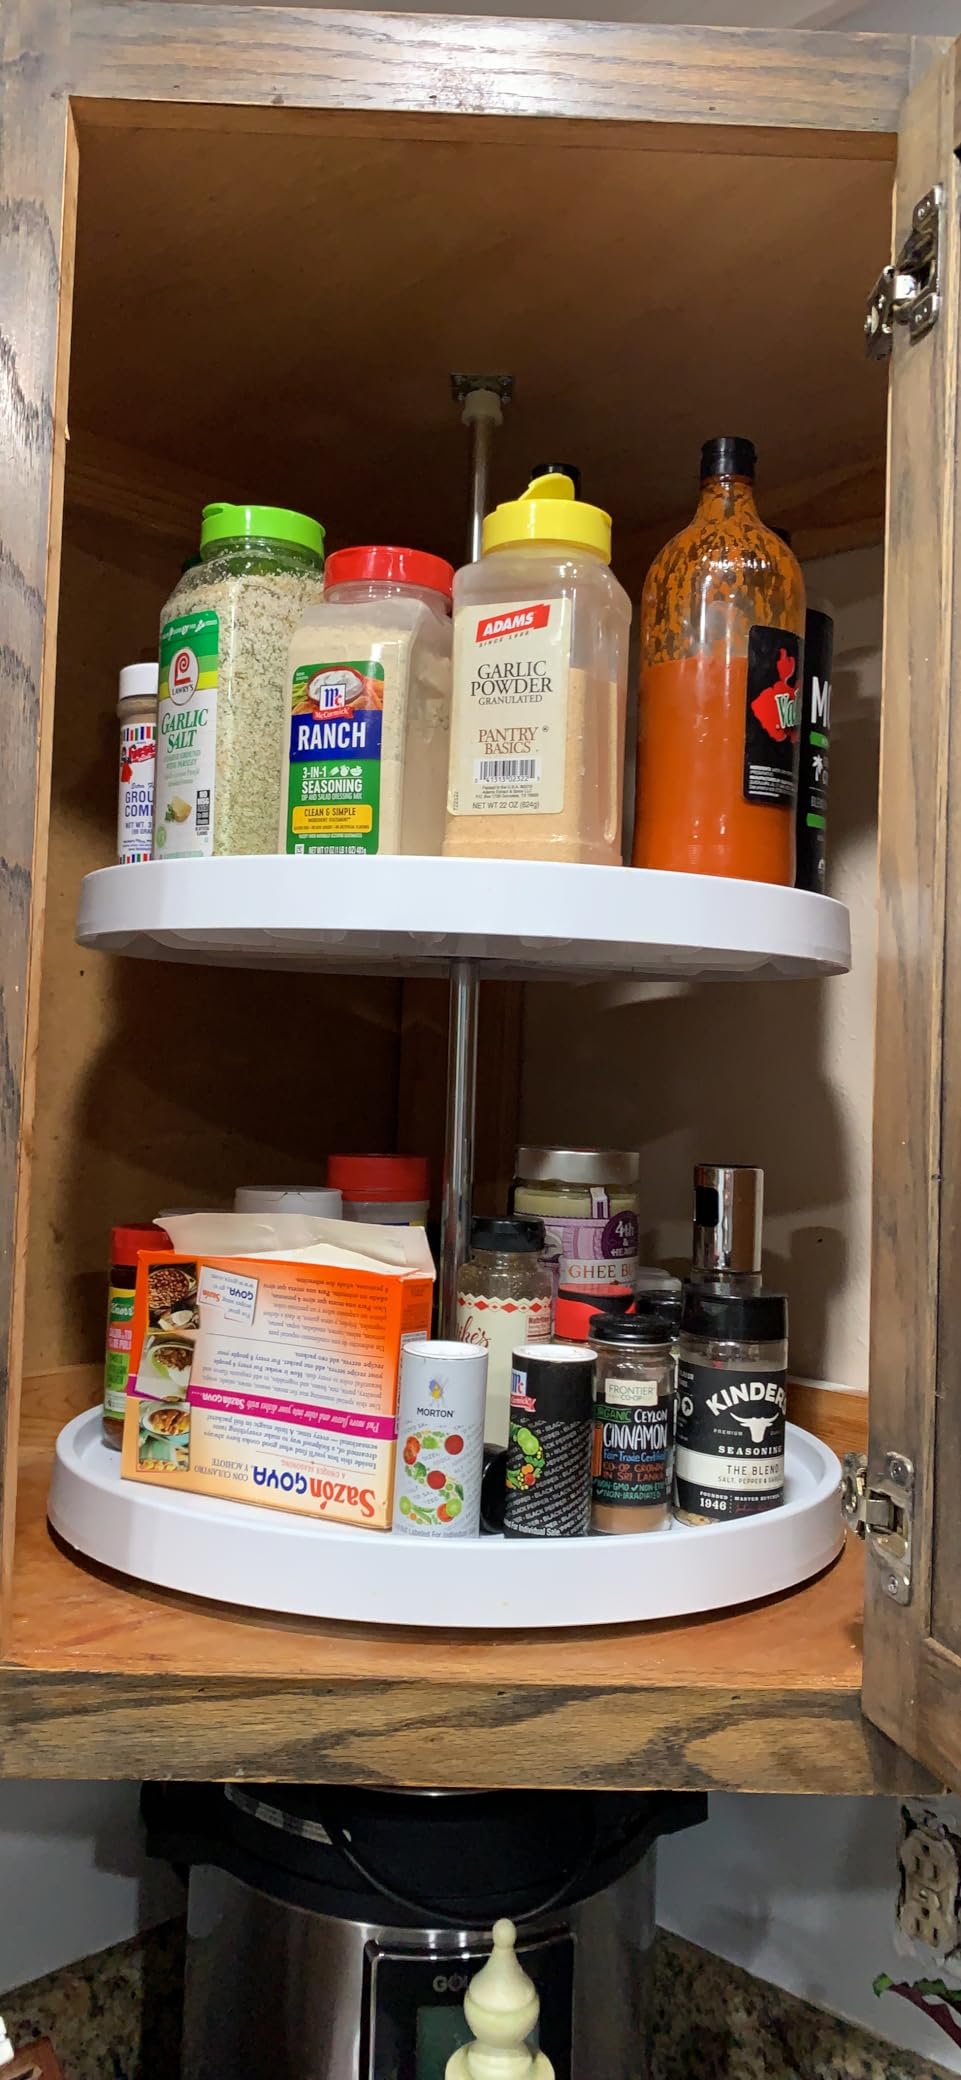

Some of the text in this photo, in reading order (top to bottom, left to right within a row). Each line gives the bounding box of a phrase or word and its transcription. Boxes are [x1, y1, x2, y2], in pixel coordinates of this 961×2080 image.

[482, 612, 534, 636] ADAMS
[477, 661, 547, 680] GARLIC
[172, 684, 194, 696] LAWRY'S
[471, 678, 553, 697] POWDER
[478, 694, 543, 706] GRANULATED
[812, 676, 832, 731] M
[161, 709, 208, 735] GARLIC
[167, 729, 198, 753] SALT
[298, 722, 366, 751] RANCH
[479, 727, 540, 743] PANTRY
[485, 741, 531, 755] BASICS
[303, 766, 327, 778] 3-IN-1
[302, 779, 362, 794] SEASONING
[487, 801, 498, 809] WT
[499, 801, 507, 809] 22
[304, 807, 324, 817] CLEAN
[332, 806, 357, 816] SIMPLE
[568, 1264, 616, 1279] GHEE
[228, 1287, 253, 1300] GOYA
[457, 1316, 491, 1348] ike's
[289, 1370, 302, 1378] How
[346, 1368, 366, 1378] recipe
[609, 1384, 653, 1396] FRONTIER
[221, 1395, 245, 1409] Sazón
[417, 1407, 454, 1418] MORTON
[634, 1408, 668, 1423] CEYLON
[253, 1421, 272, 1431] magic
[330, 1412, 350, 1428] flavor
[348, 1418, 365, 1427] more
[228, 1425, 262, 1438] everything
[365, 1420, 379, 1433] Put
[713, 1428, 743, 1436] PREMIUM
[203, 1430, 224, 1440] always
[313, 1432, 329, 1441] every
[603, 1423, 668, 1450] CINNAMON
[241, 1438, 260, 1446] cooks
[261, 1439, 277, 1449] good
[278, 1444, 293, 1452] what
[302, 1439, 330, 1451] foolproof
[339, 1439, 377, 1451] sensational
[294, 1447, 307, 1455] find
[308, 1448, 325, 1459] you'll
[327, 1453, 338, 1461] box
[346, 1448, 377, 1460] dreamed
[620, 1451, 640, 1462] Trade
[211, 1458, 242, 1469] ACHIOTE
[340, 1456, 352, 1464] this
[354, 1459, 376, 1469] Inside
[193, 1465, 248, 1481] CON CULANTRO
[727, 1463, 779, 1476] THE BLEND
[251, 1465, 308, 1494] GOYA
[618, 1472, 632, 1480] SRI
[306, 1477, 378, 1518] Sazón
[534, 1487, 554, 1498] BLACK
[700, 1491, 728, 1500] FOUNDED
[700, 1498, 727, 1511] 1946
[525, 1508, 545, 1520] BLACK
[519, 1523, 546, 1536] Individual
